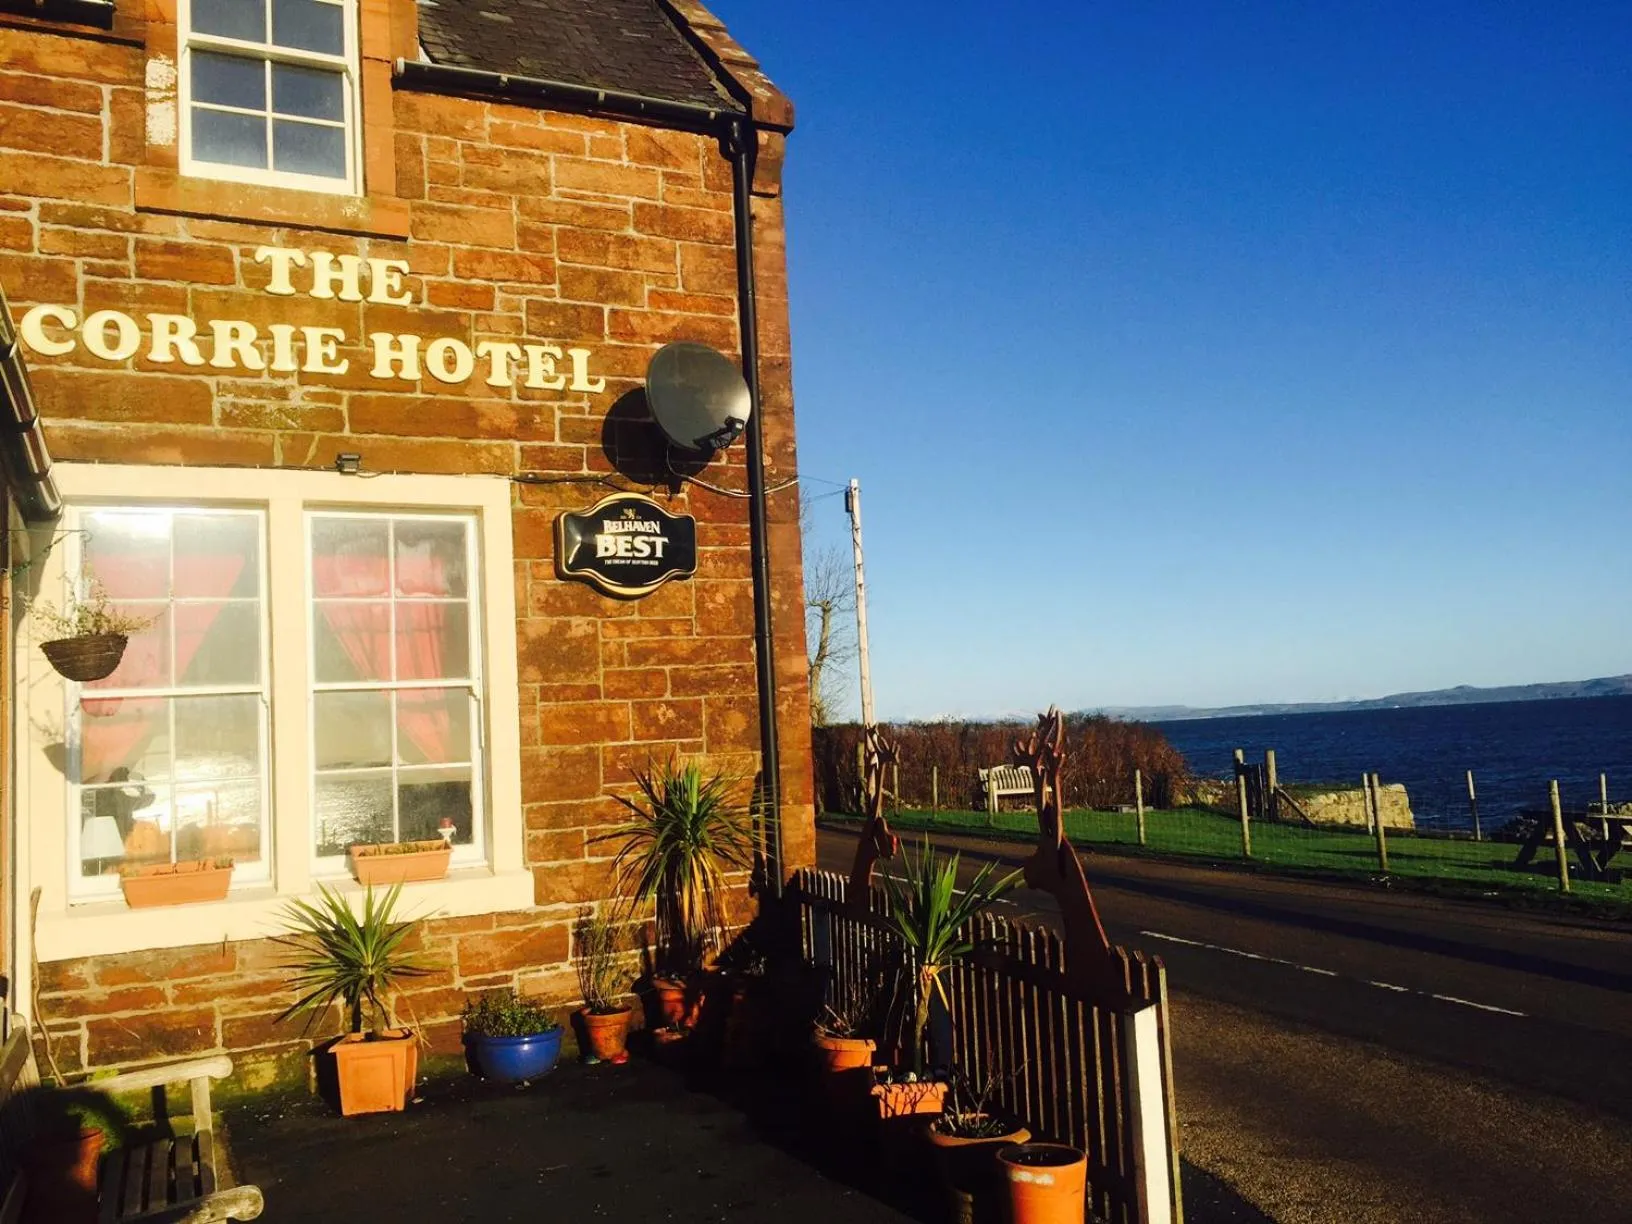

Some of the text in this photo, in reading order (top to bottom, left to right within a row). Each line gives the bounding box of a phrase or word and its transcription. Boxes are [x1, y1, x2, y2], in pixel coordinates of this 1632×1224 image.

[256, 246, 413, 307] THE
[20, 303, 606, 394] CORRIE HOTEL
[595, 534, 669, 558] BEST
[603, 520, 661, 534] BELHAVEN
